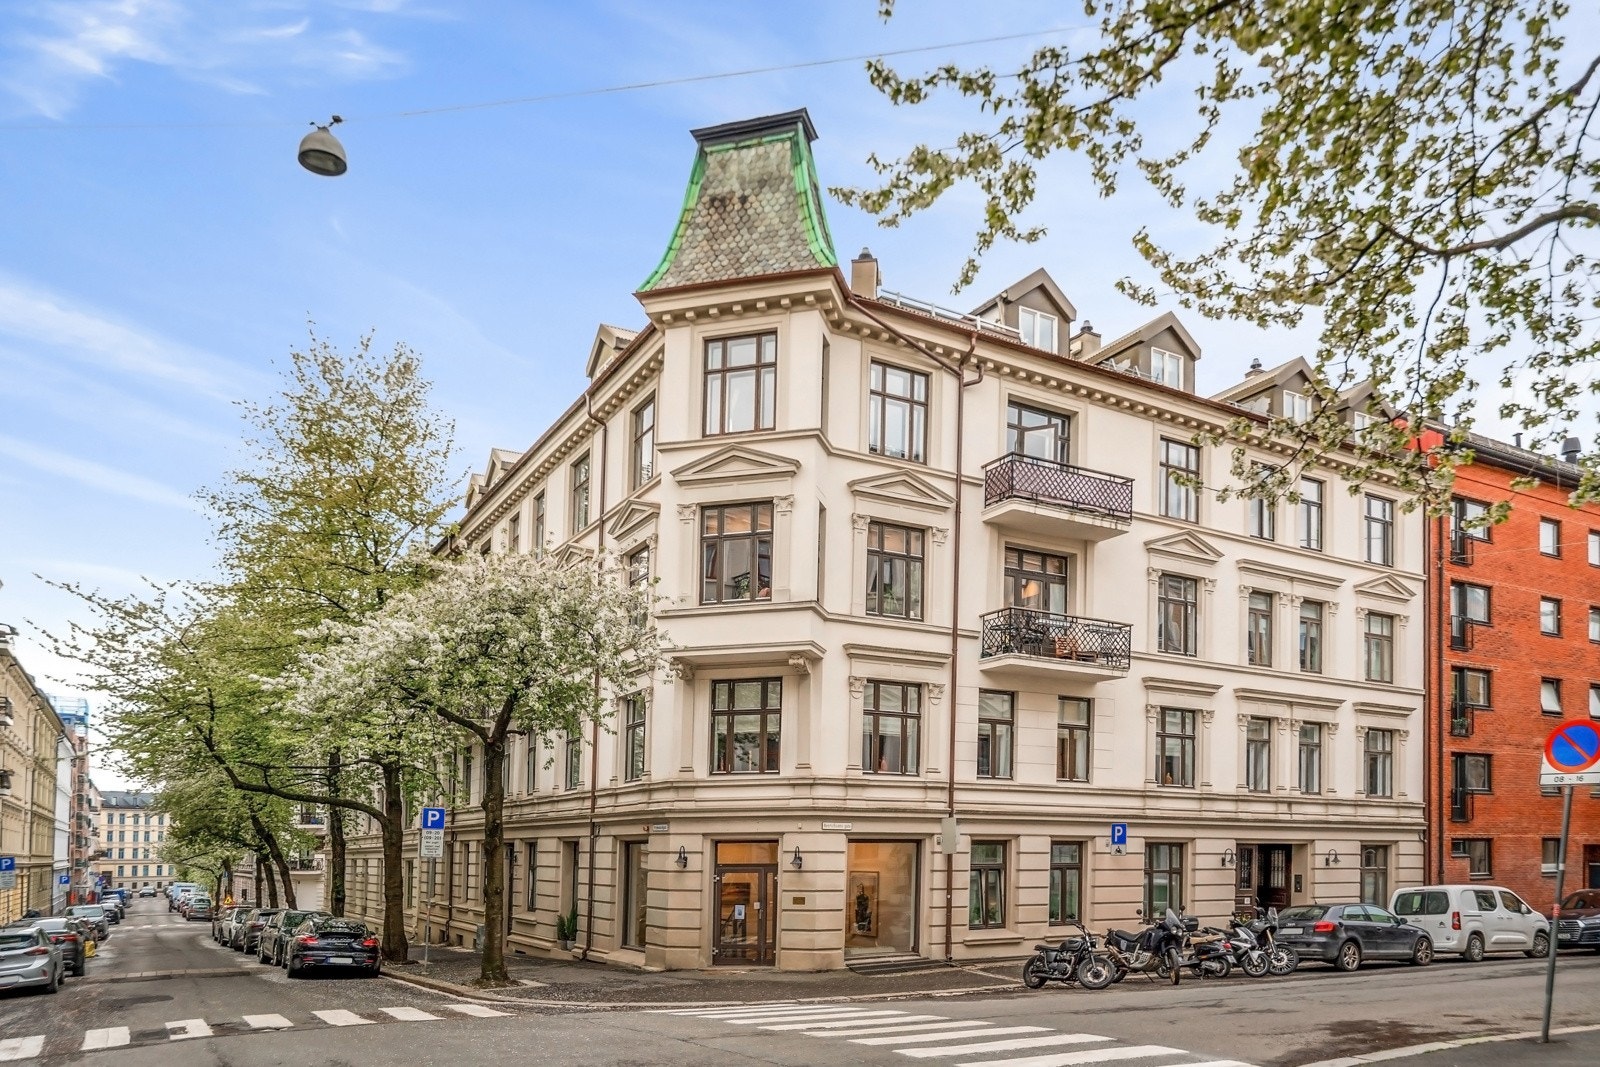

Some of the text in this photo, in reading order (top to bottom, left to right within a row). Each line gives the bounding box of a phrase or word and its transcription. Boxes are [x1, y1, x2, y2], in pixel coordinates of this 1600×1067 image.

[1553, 775, 1565, 783] 08
[427, 810, 440, 827] P
[1114, 826, 1123, 842] P
[1, 858, 12, 870] P
